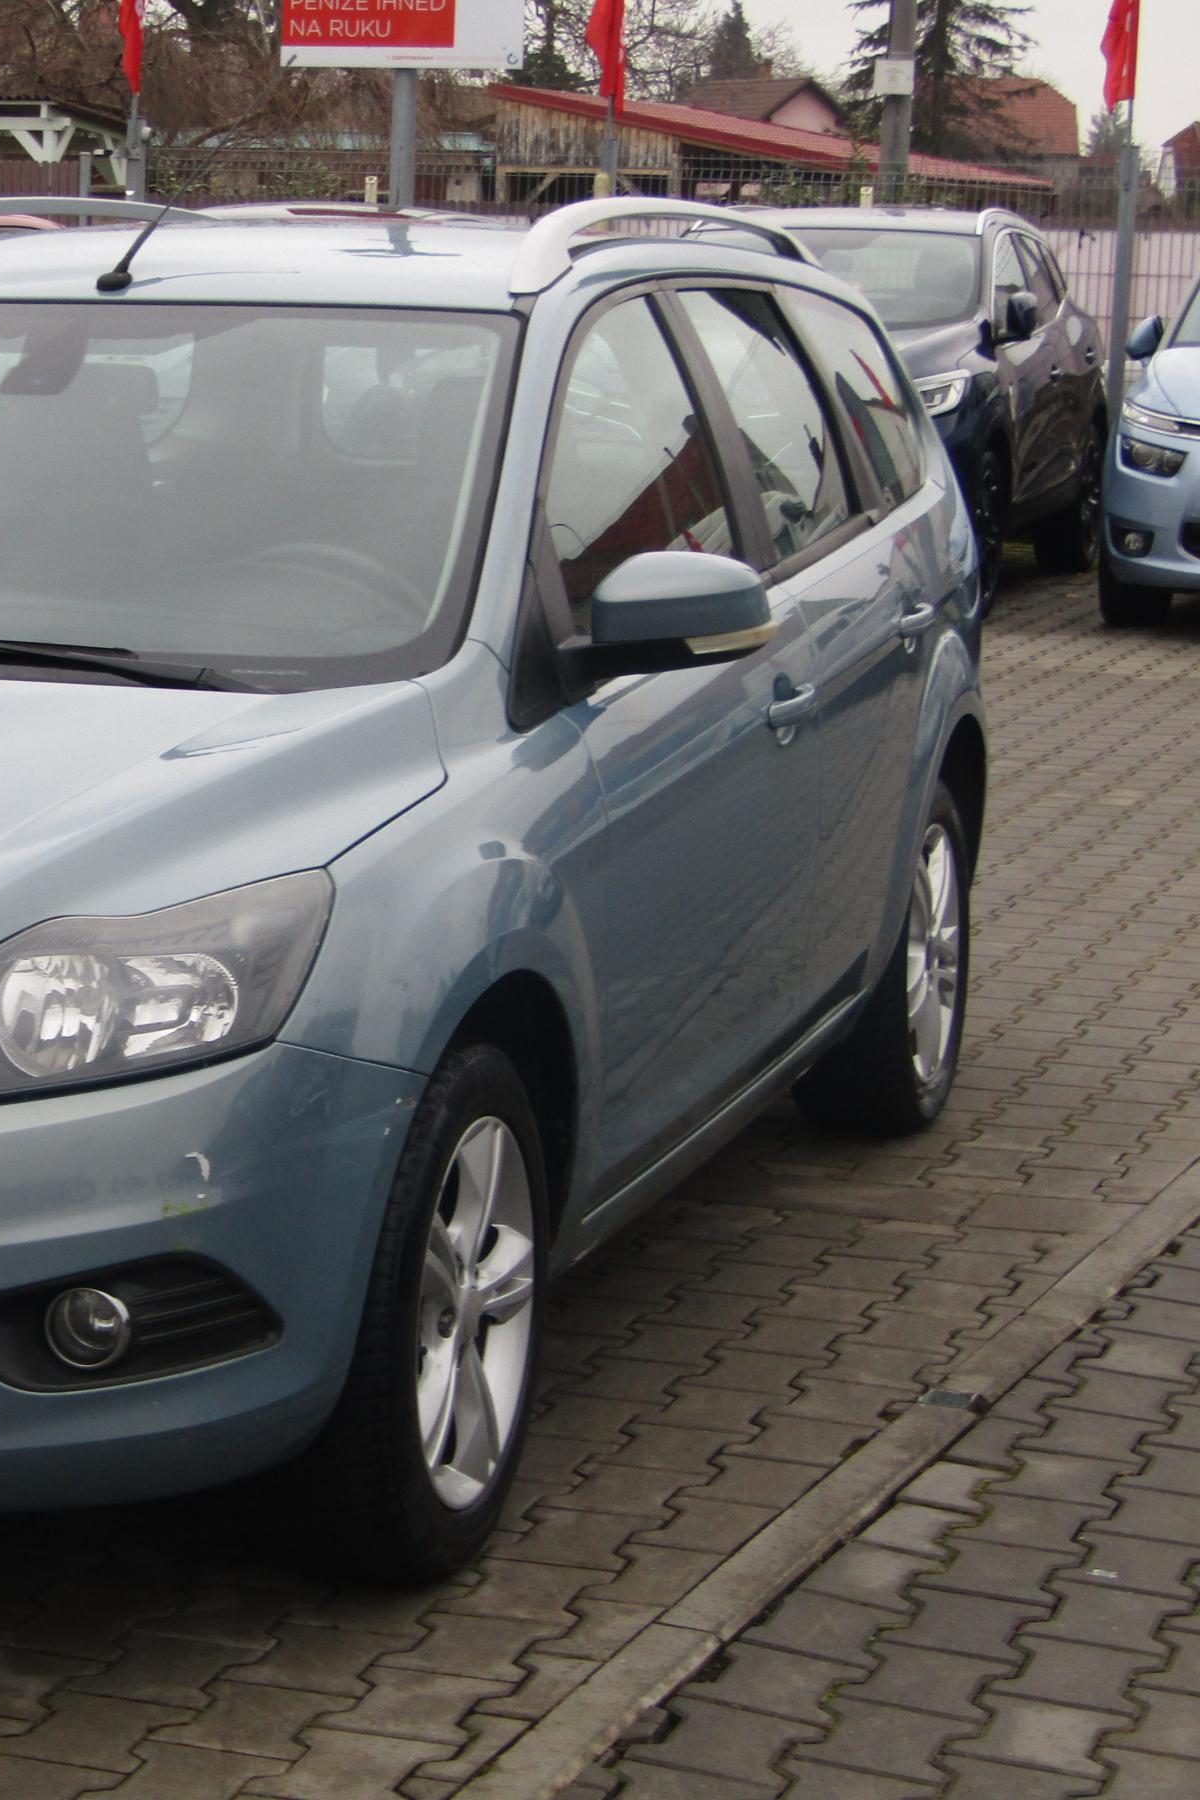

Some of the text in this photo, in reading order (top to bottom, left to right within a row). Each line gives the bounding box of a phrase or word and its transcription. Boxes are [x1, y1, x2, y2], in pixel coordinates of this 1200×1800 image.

[376, 0, 446, 12] IHNED
[289, 19, 392, 38] NA RUKU
